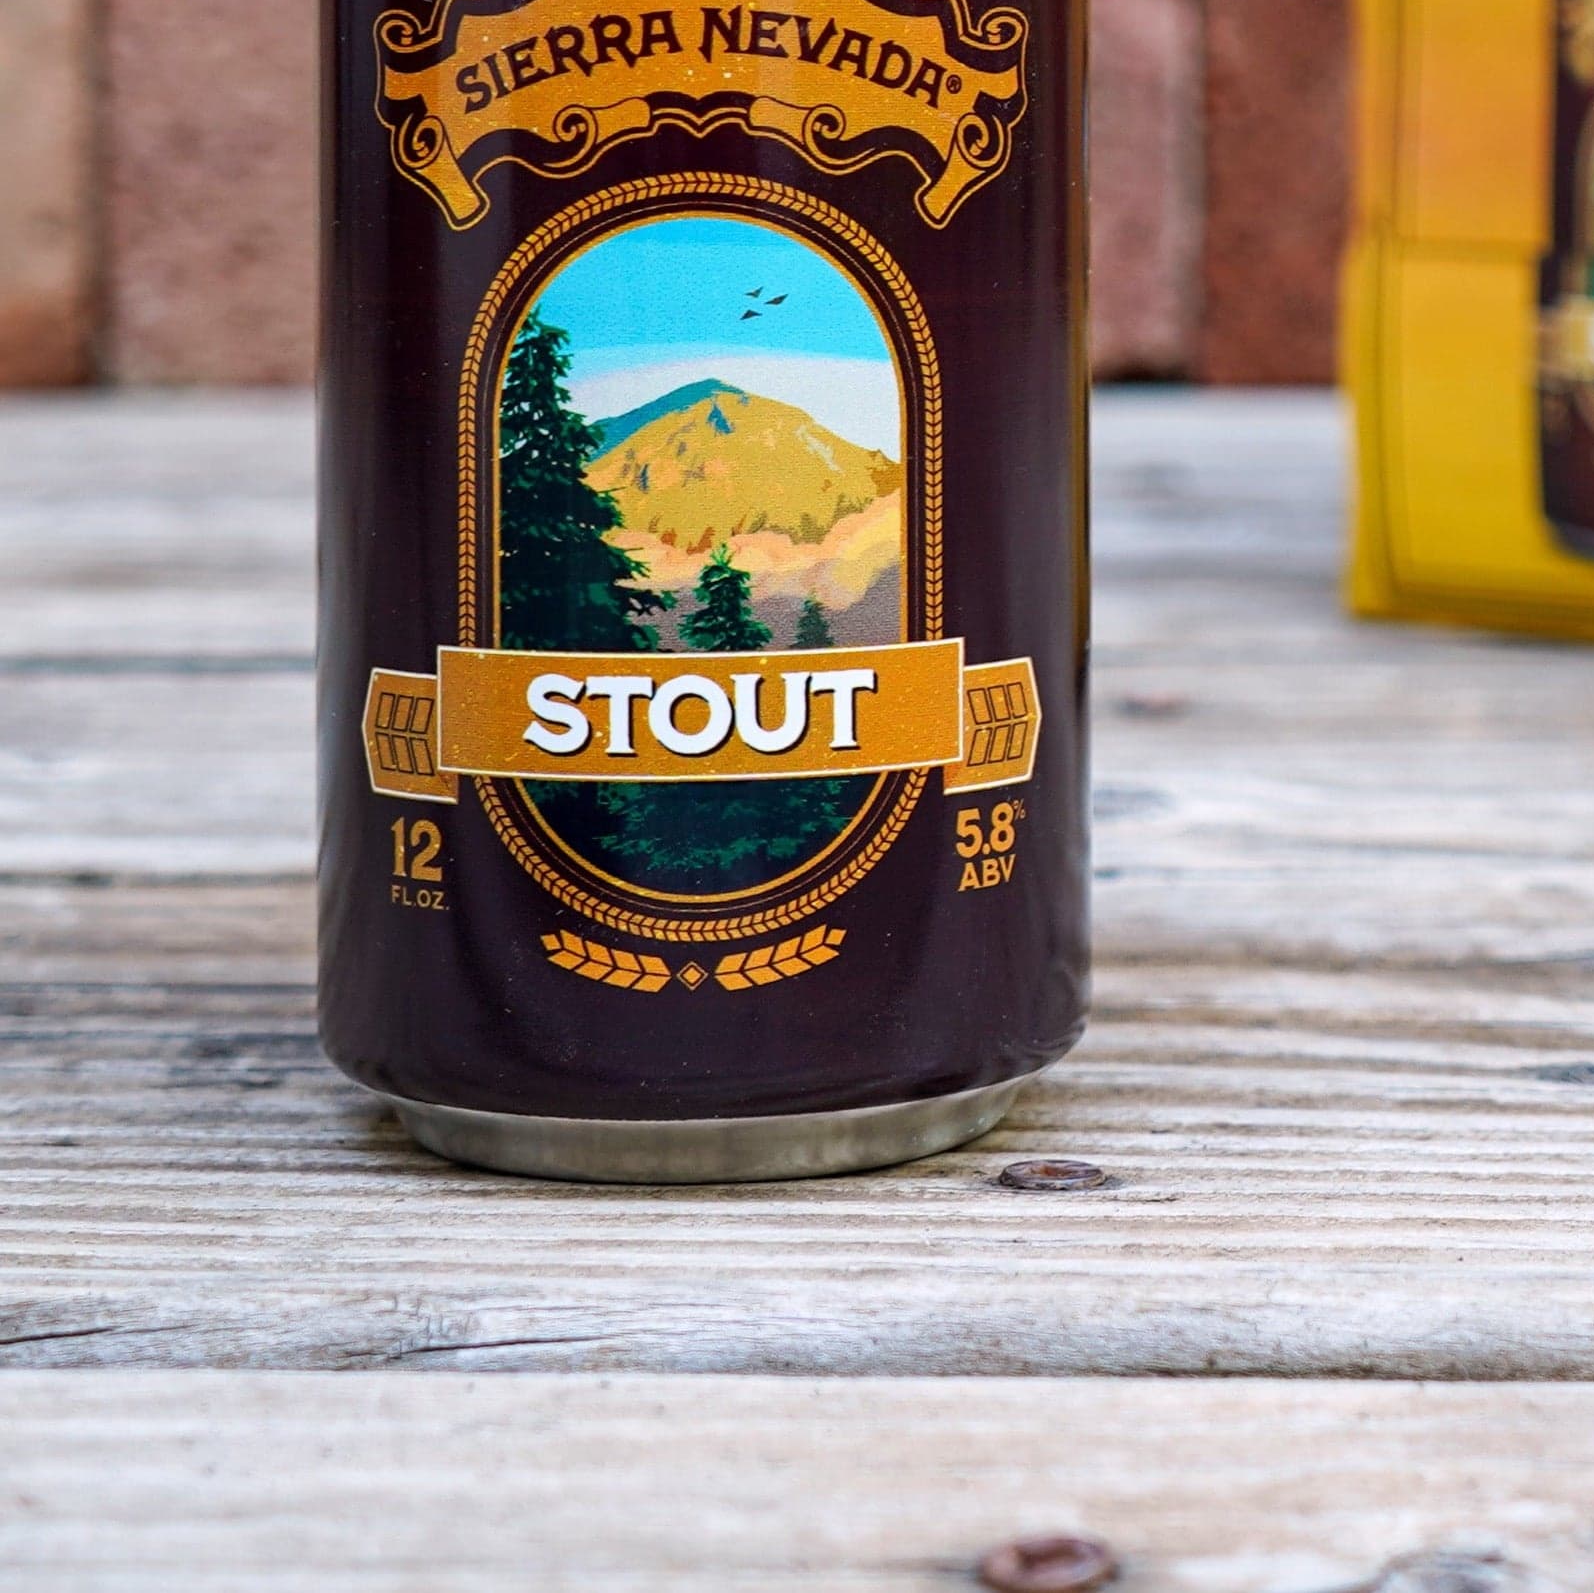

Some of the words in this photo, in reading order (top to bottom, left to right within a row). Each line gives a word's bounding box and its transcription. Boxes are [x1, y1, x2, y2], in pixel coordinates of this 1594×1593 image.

[455, 9, 683, 115] SIERRA
[522, 668, 877, 757] STOUT
[390, 815, 443, 882] 12
[957, 853, 1016, 893] ABV
